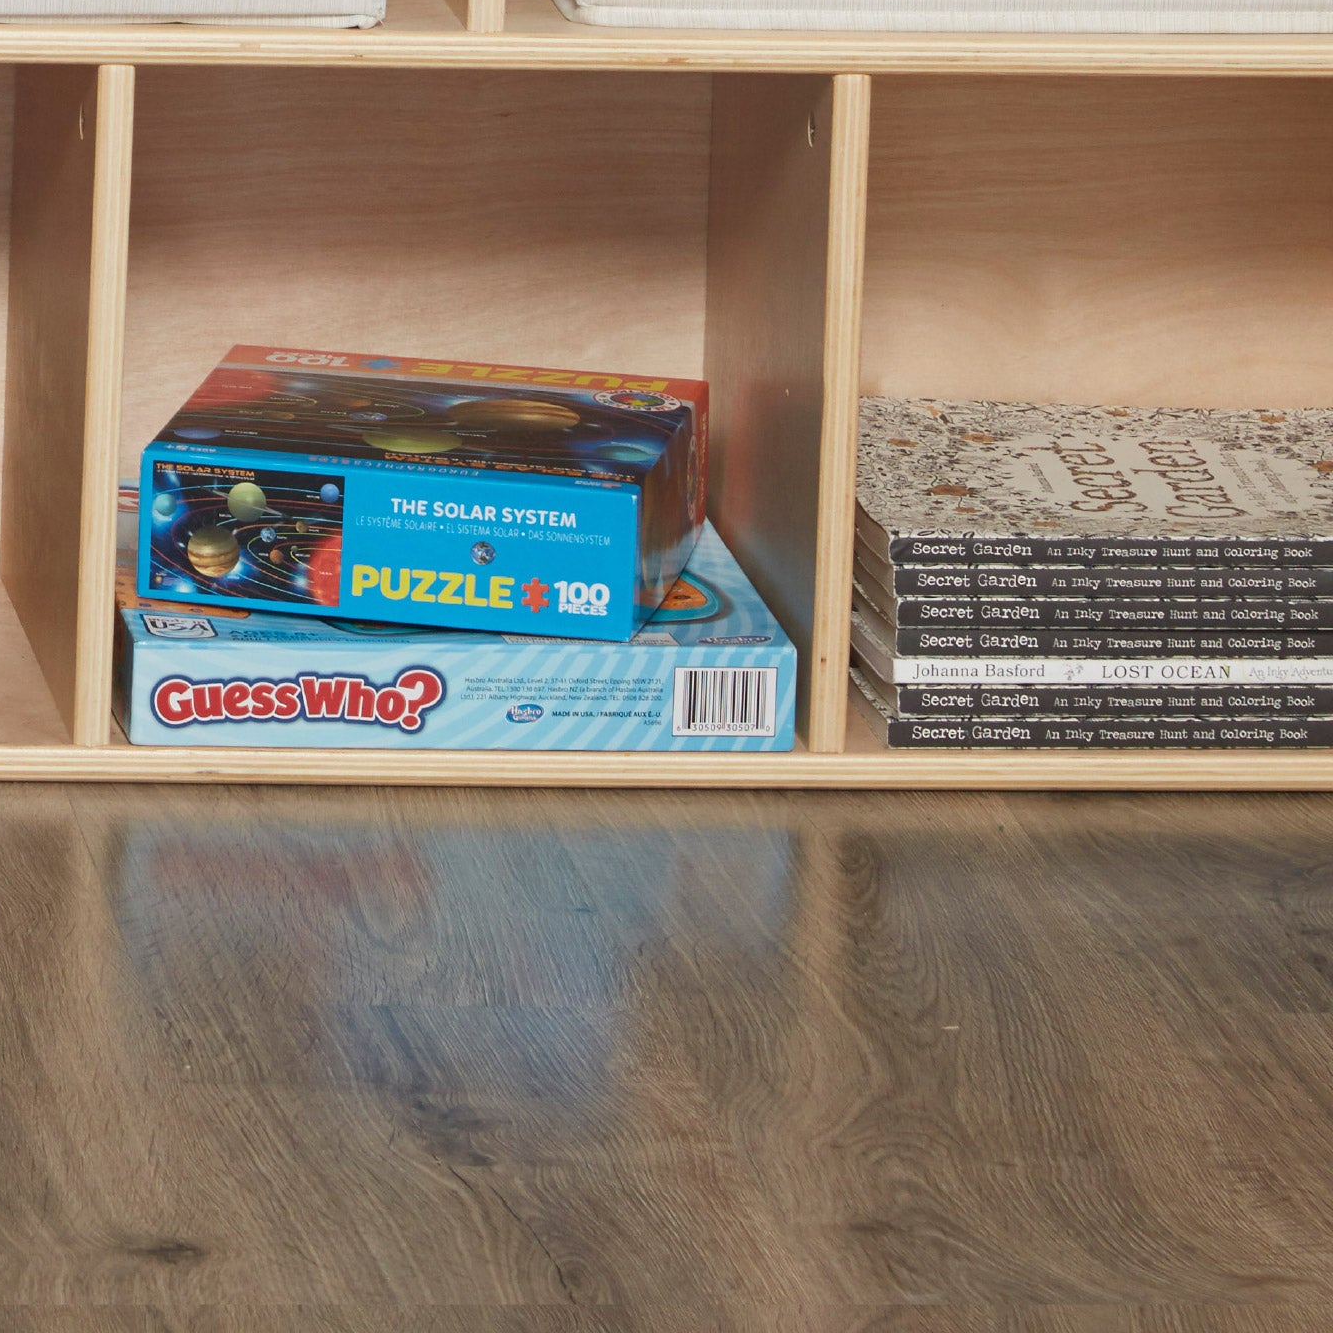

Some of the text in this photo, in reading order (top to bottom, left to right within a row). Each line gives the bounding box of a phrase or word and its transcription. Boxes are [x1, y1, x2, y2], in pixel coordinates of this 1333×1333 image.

[265, 350, 669, 393] PUZZLE 100
[156, 463, 255, 477] THE SOLAR SYSTEM
[1023, 441, 1148, 512] Secret
[1130, 439, 1251, 518] Garden
[391, 498, 577, 528] THE SOLAR SYSTEM
[355, 515, 611, 546] LE SYSTÈME SOLAIRE EL SISTEMA SOLAR DAS SONNENSYSTEM
[912, 542, 1033, 557] Secret Garden
[1047, 546, 1313, 560] An Inky Treasure Hunt and Coloring Book
[351, 564, 611, 609] PUZZLE 100
[917, 573, 1038, 588] Secret Garden
[1051, 577, 1317, 591] An Inky Treasure Hunt and Coloring Book
[558, 602, 608, 616] PIECES
[920, 604, 1041, 620] Secret Garden
[1054, 608, 1319, 623] An Inky Treasure Hunt and Coloring Book
[919, 633, 1039, 649] Secret Garden
[1052, 637, 1316, 651] An Inky Treasure Hunt and Coloring Book
[913, 663, 1046, 679] Johanna Basford
[1102, 665, 1231, 679] LOST OCEAN
[1249, 666, 1266, 681] An
[1267, 666, 1288, 681] Inky
[921, 692, 1040, 708] Secret Garden
[1054, 695, 1315, 710] An Inky Treasure Hunt and Coloring Book
[510, 705, 542, 716] Hasbro
[691, 723, 722, 732] 30509
[725, 723, 754, 732] 30507
[911, 725, 1032, 741] Secret Garden
[1045, 728, 1308, 742] An Inky Treasure Hunt and Coloring Book
